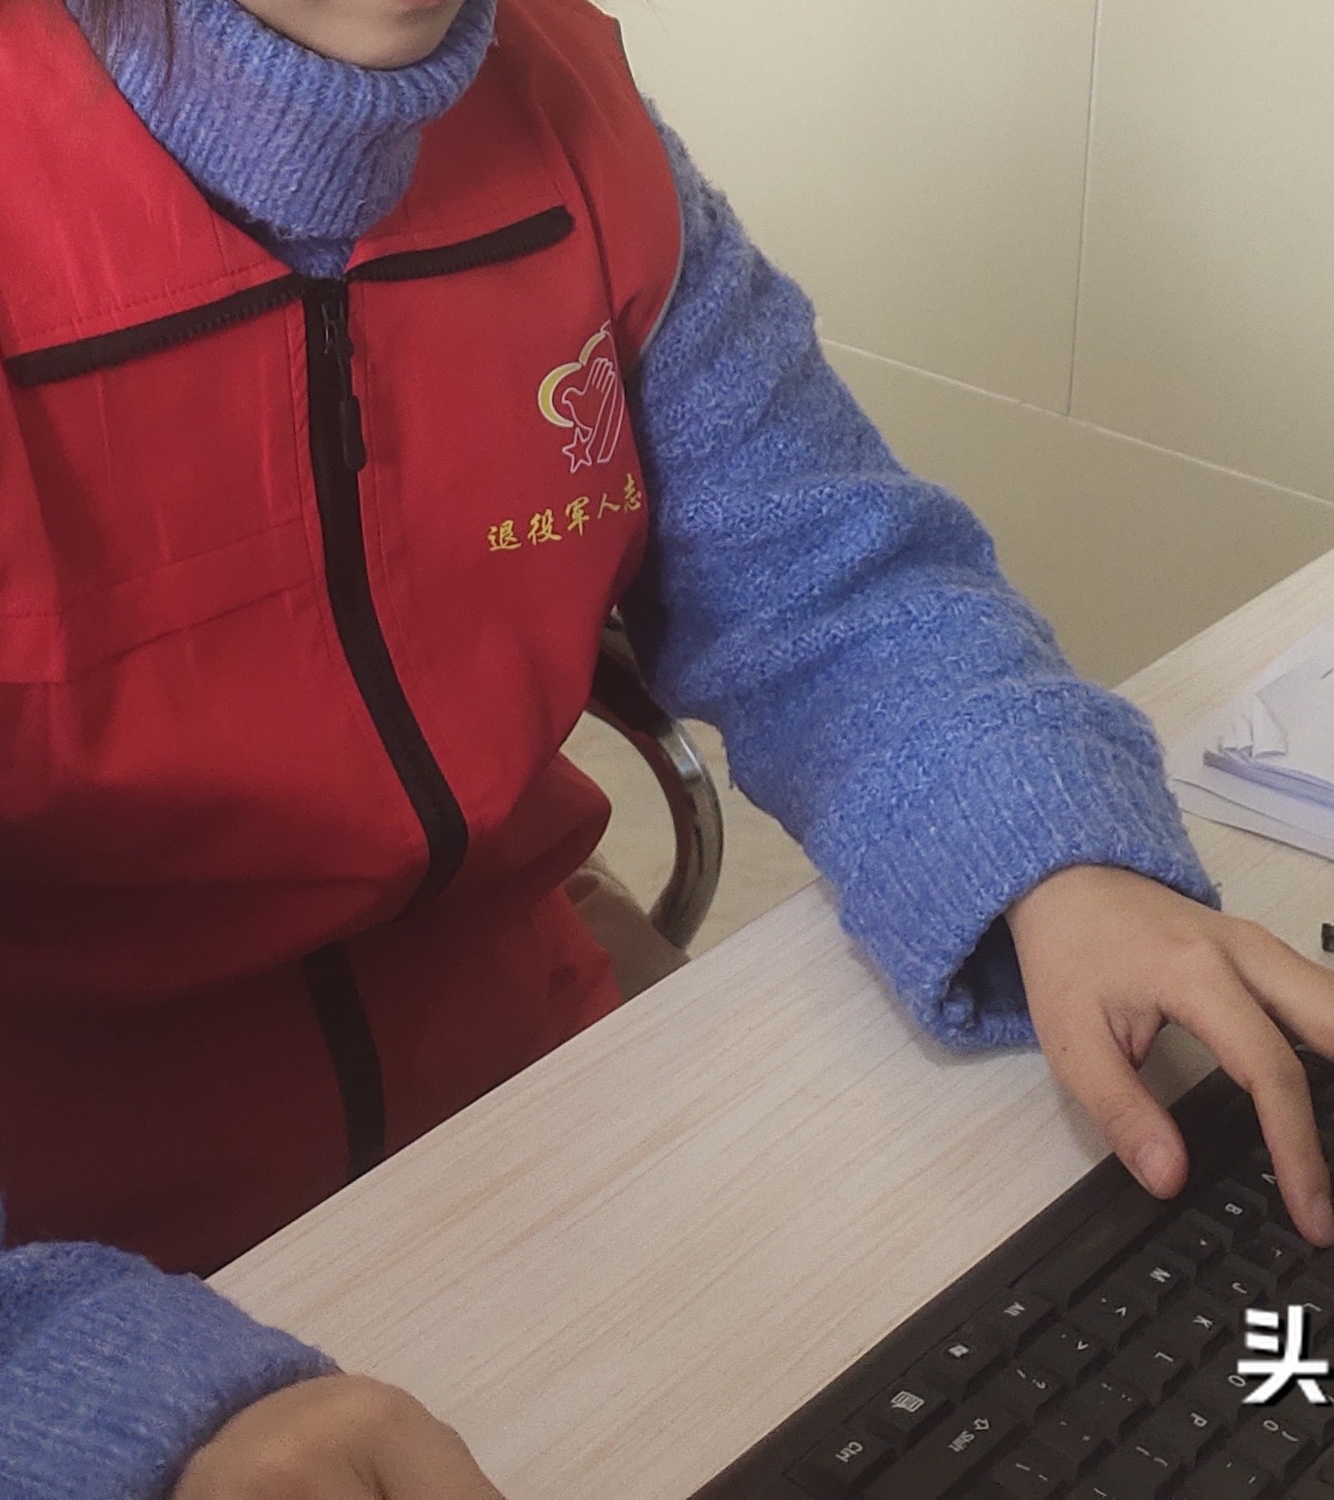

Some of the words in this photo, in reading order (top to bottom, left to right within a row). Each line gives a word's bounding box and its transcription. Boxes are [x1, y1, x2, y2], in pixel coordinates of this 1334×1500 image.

[487, 473, 643, 551] 退役军人志
